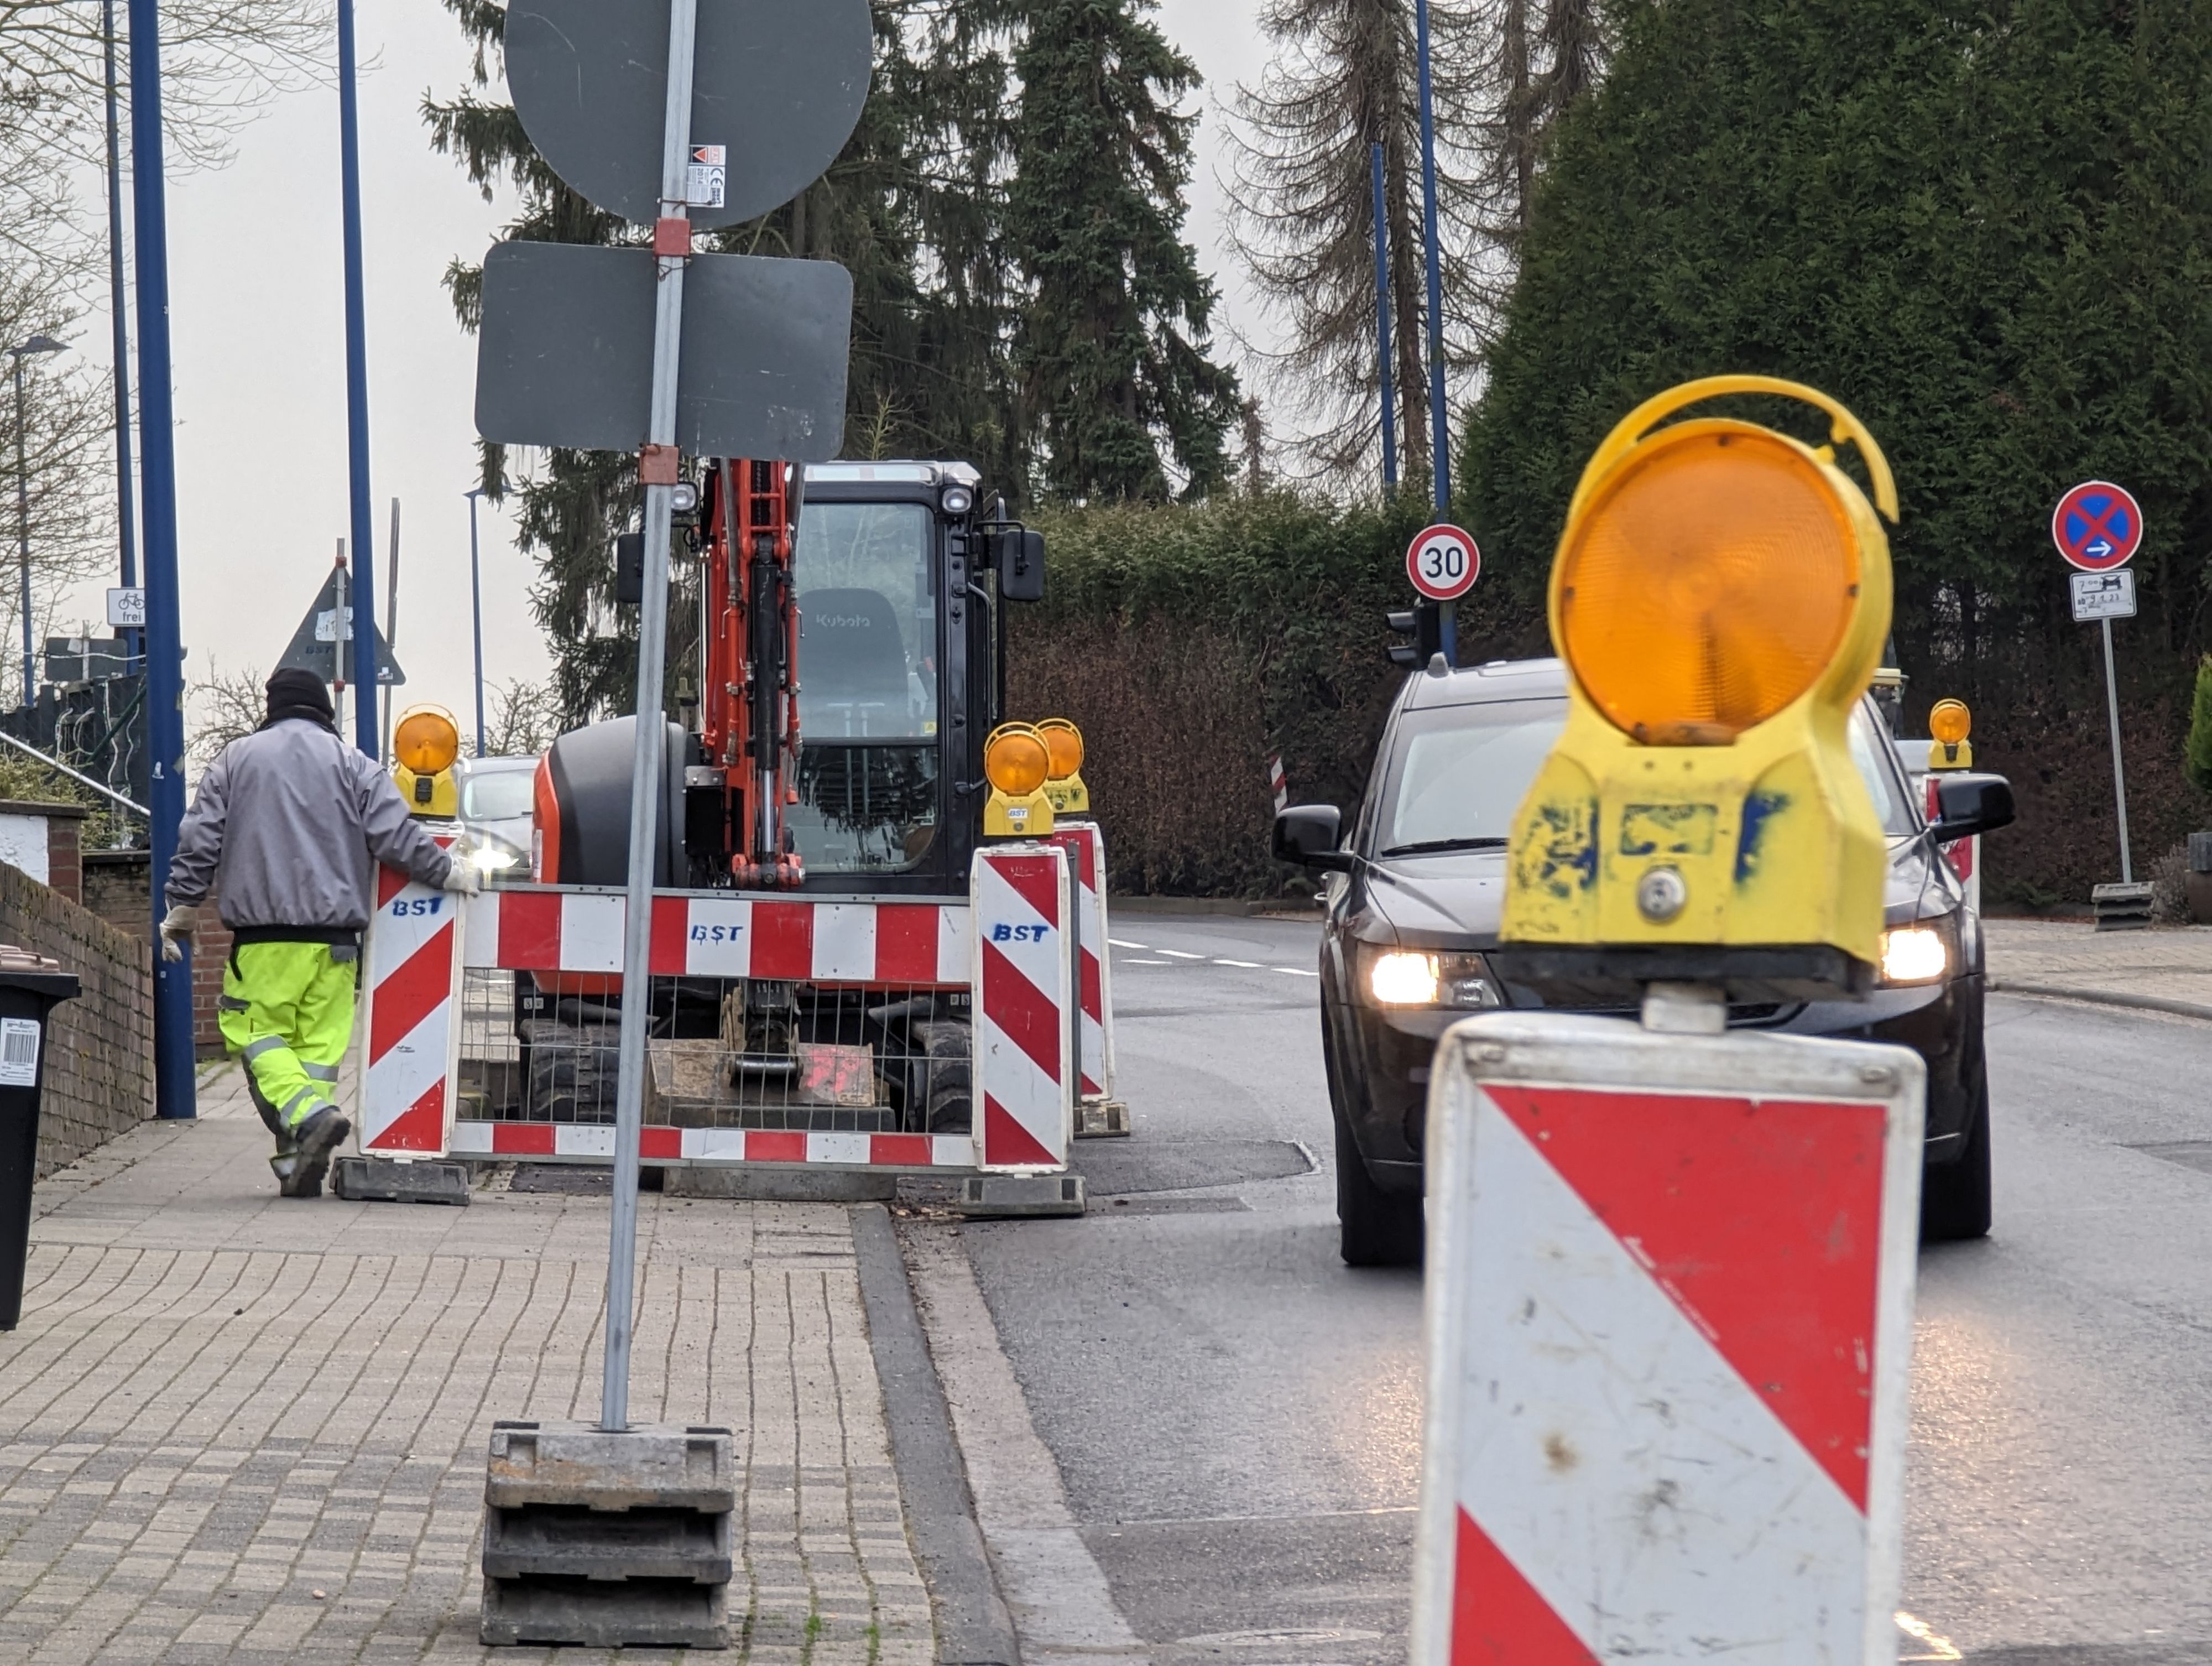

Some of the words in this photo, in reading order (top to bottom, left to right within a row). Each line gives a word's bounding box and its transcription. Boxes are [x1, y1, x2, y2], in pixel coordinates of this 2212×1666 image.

[1425, 546, 1463, 578] 30
[123, 611, 142, 622] frei
[816, 614, 870, 627] Kubota
[392, 896, 444, 917] BST
[691, 924, 744, 943] BST
[993, 923, 1049, 943] BST
